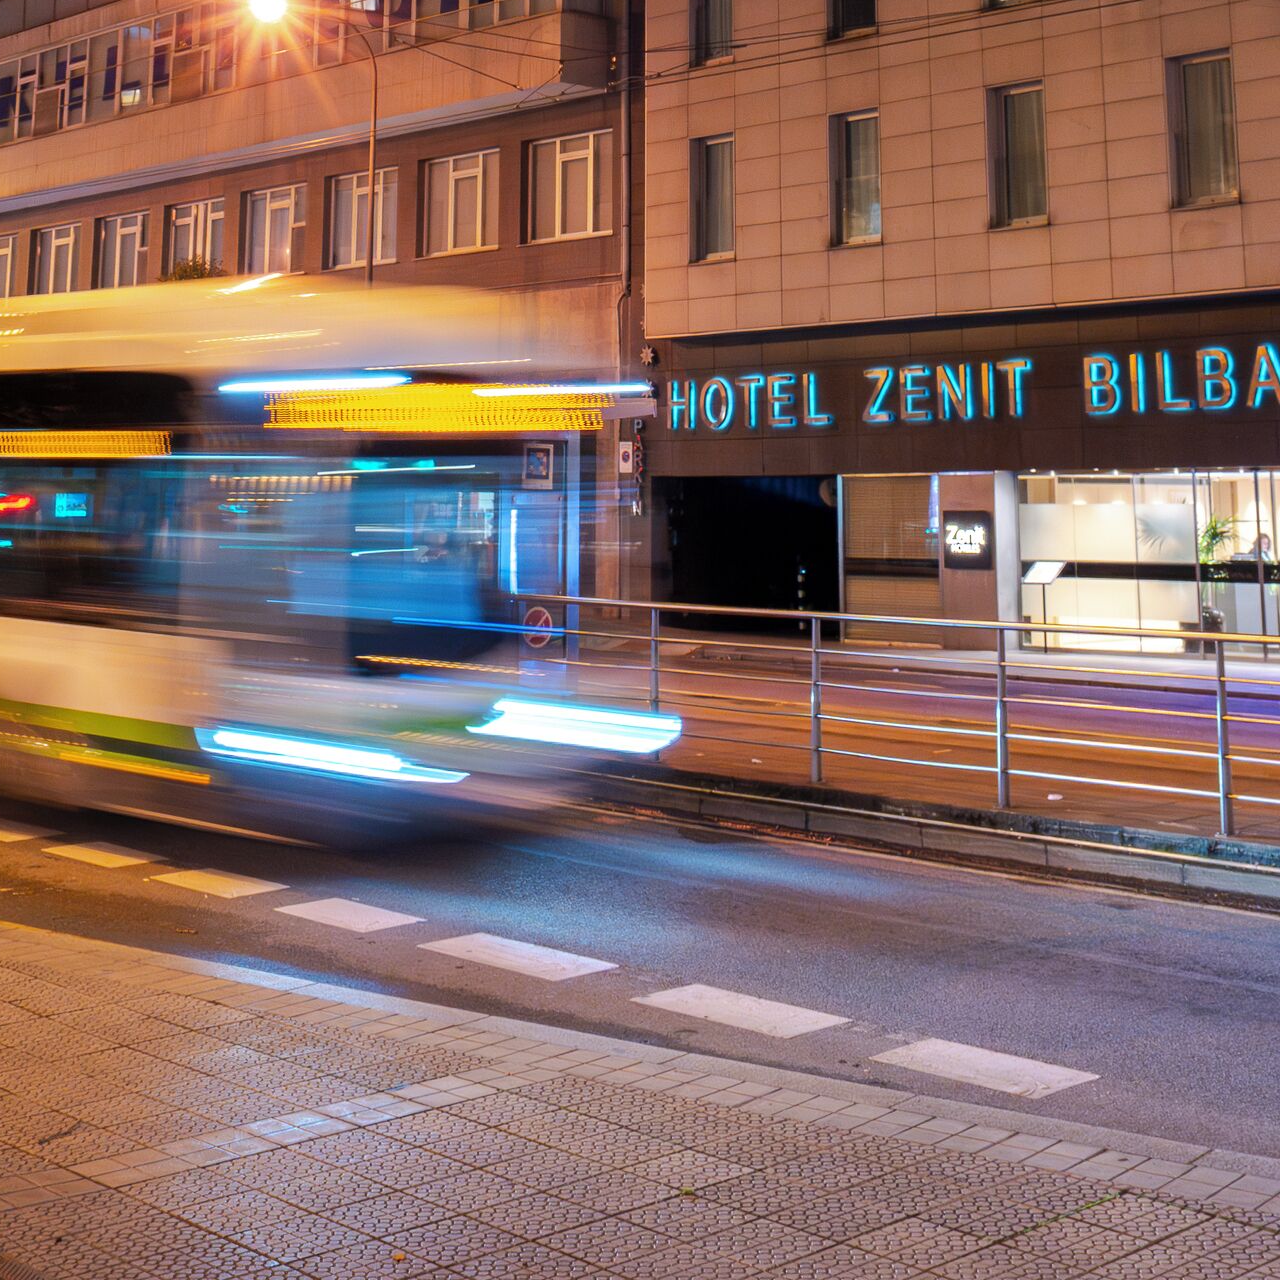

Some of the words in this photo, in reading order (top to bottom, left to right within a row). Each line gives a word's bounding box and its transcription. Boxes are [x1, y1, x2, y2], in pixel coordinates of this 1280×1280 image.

[666, 372, 834, 432] HOTEL
[862, 358, 1032, 424] ZENIT
[945, 524, 986, 545] Zenit
